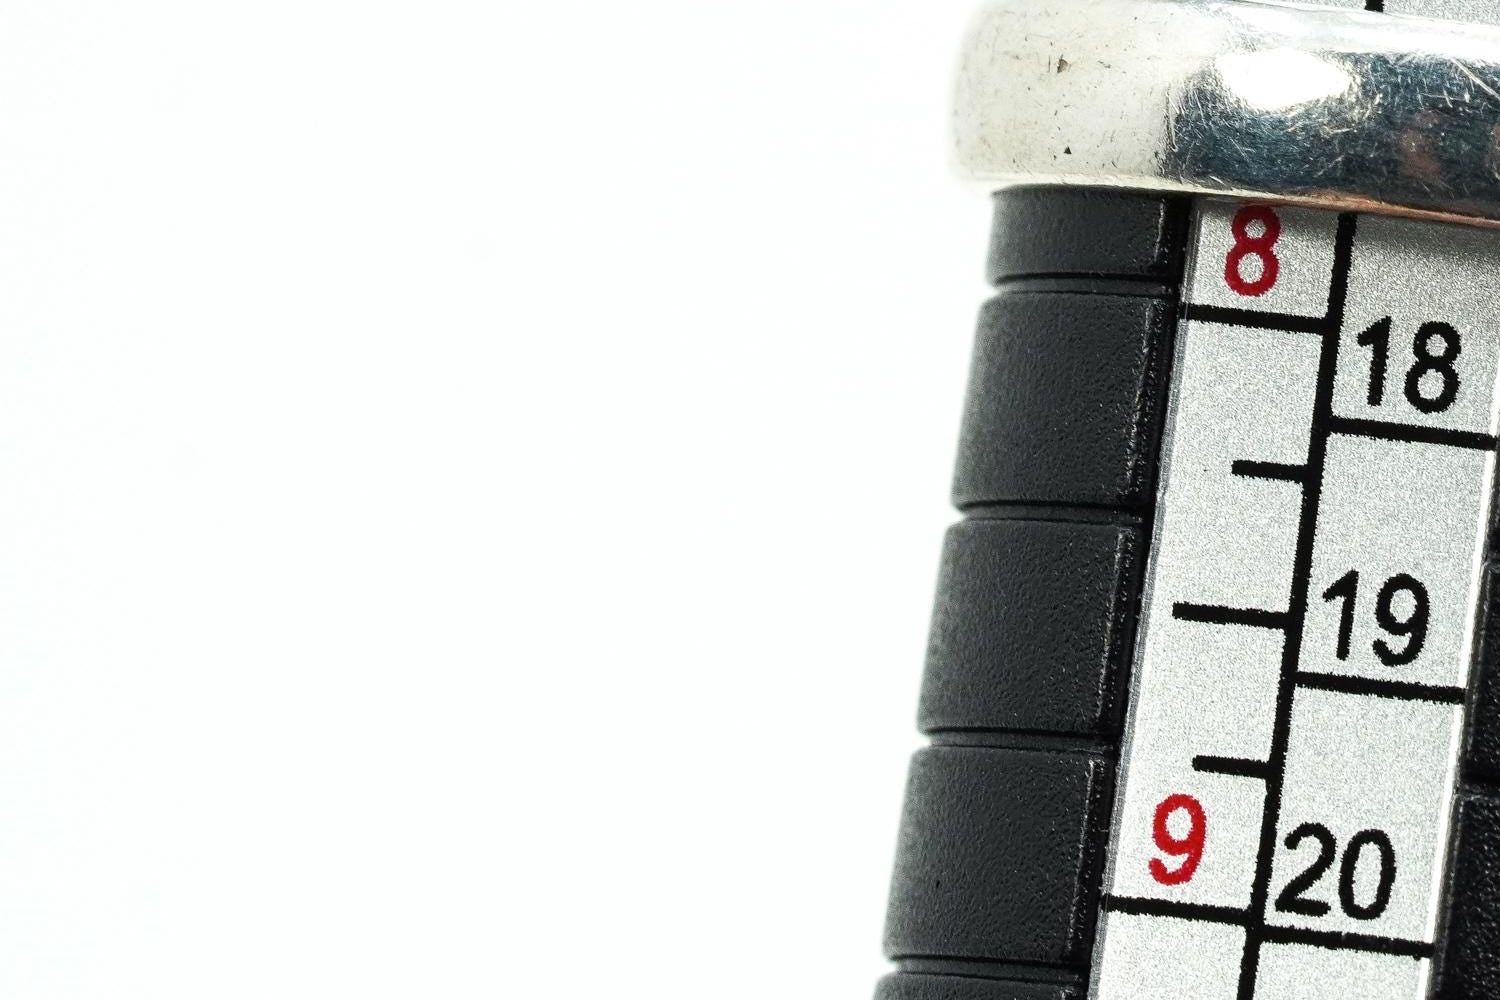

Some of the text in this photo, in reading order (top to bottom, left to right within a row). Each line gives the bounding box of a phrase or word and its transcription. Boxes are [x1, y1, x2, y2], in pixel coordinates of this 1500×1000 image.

[1224, 203, 1281, 297] 8
[1356, 314, 1463, 416] 18
[1320, 568, 1432, 668] 19
[1147, 793, 1208, 887] 9
[1273, 821, 1398, 922] 20
